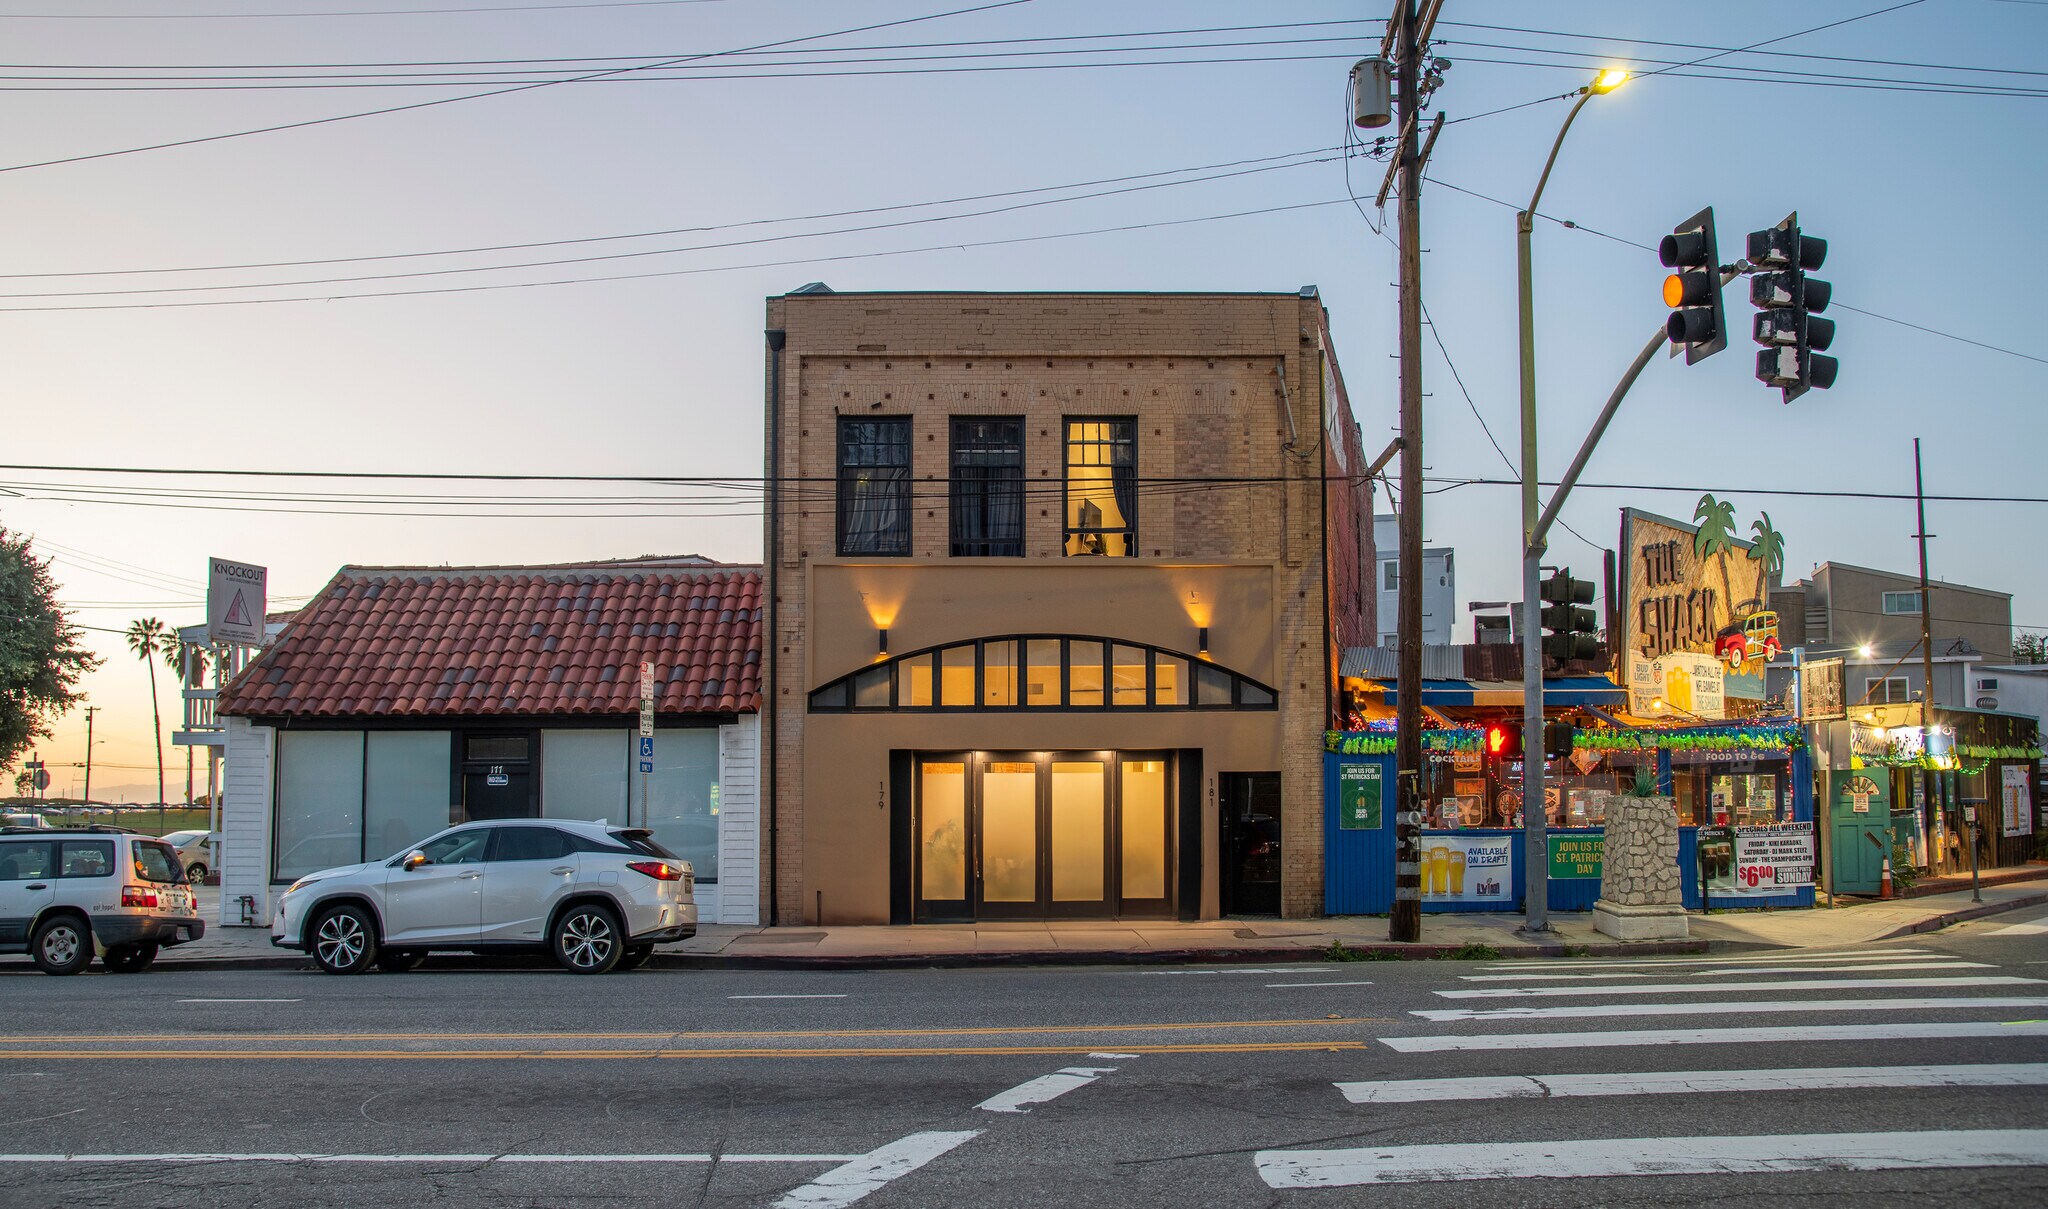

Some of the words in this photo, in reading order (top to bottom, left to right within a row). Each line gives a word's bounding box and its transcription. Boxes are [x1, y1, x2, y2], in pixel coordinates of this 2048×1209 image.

[1642, 541, 1684, 588] THE
[214, 563, 264, 581] KNOCKOUT
[1641, 588, 1717, 659] SHACK
[1636, 664, 1649, 672] BUD
[1635, 672, 1650, 682] LIGHT
[1429, 755, 1480, 763] COCKTAILS
[1737, 825, 1768, 833] SPECIALS
[1781, 823, 1811, 831] WEEKEND
[1468, 847, 1507, 856] AVAILABLE
[1559, 842, 1578, 851] JOIN
[1580, 842, 1592, 851] US
[1594, 842, 1604, 851] FO
[1468, 856, 1478, 864] ON
[1481, 856, 1508, 864] DRAFT!
[1556, 853, 1568, 863] ST.
[1577, 864, 1593, 873] DAY
[1777, 872, 1812, 883] SUNDAY
